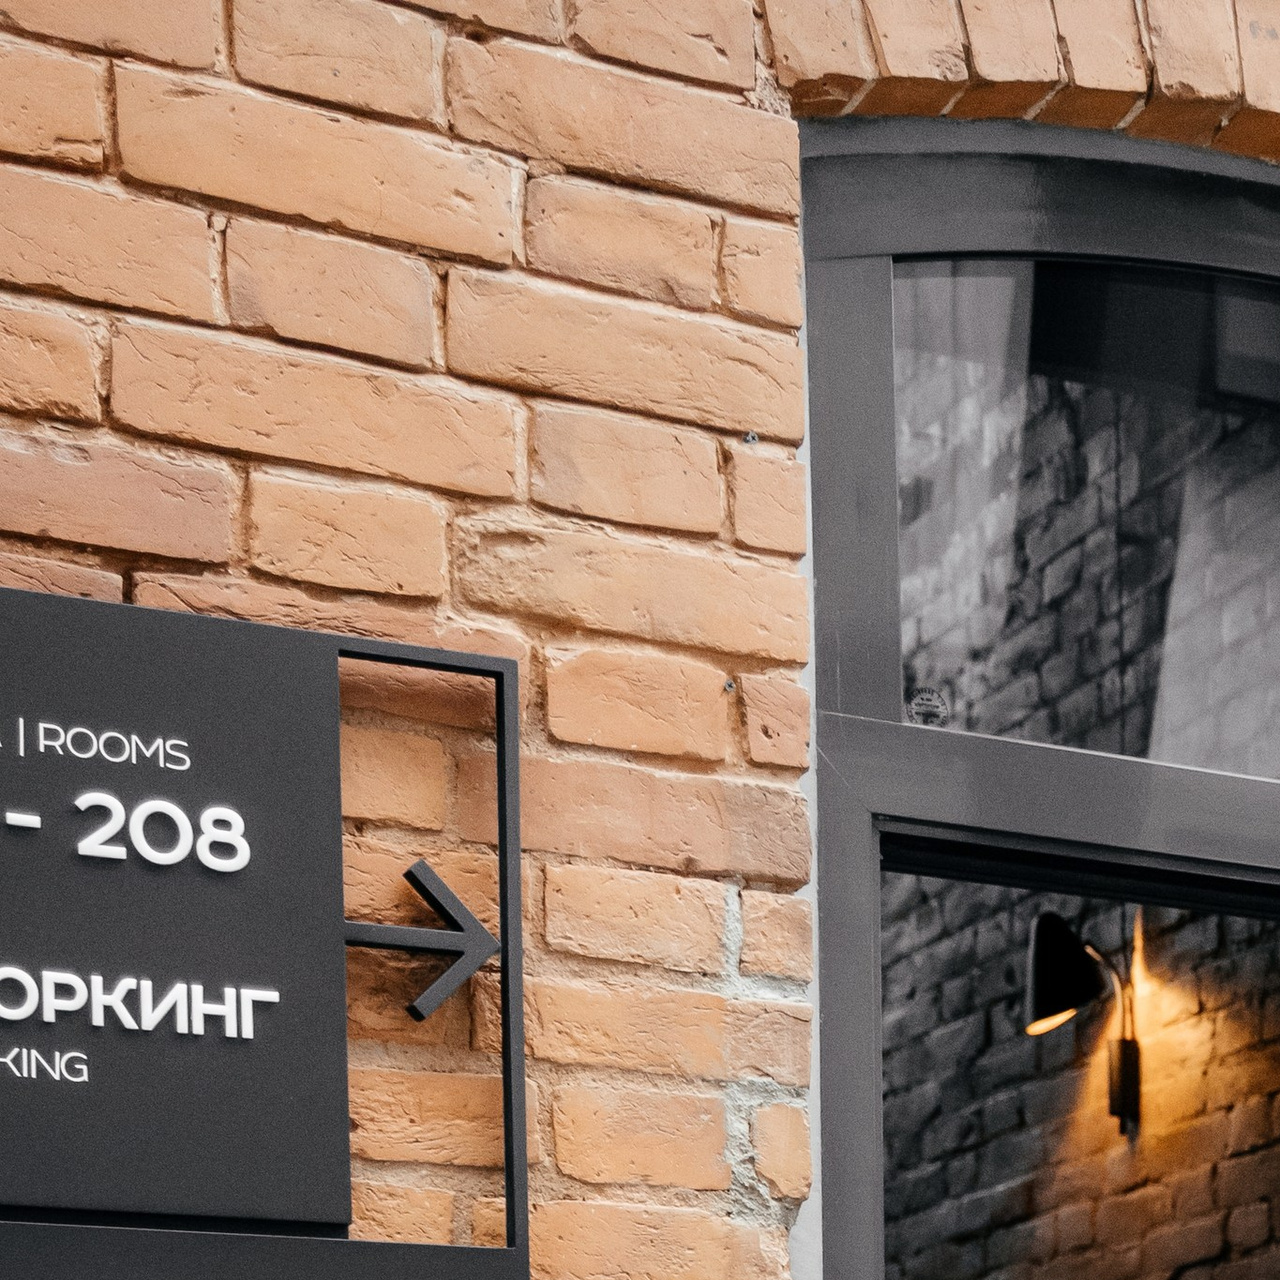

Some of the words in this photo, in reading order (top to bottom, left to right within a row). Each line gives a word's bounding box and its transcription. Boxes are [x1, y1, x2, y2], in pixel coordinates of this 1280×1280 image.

[38, 722, 191, 770] ROOMS
[74, 789, 252, 872] 208
[0, 967, 280, 1039] ОРКИНГ
